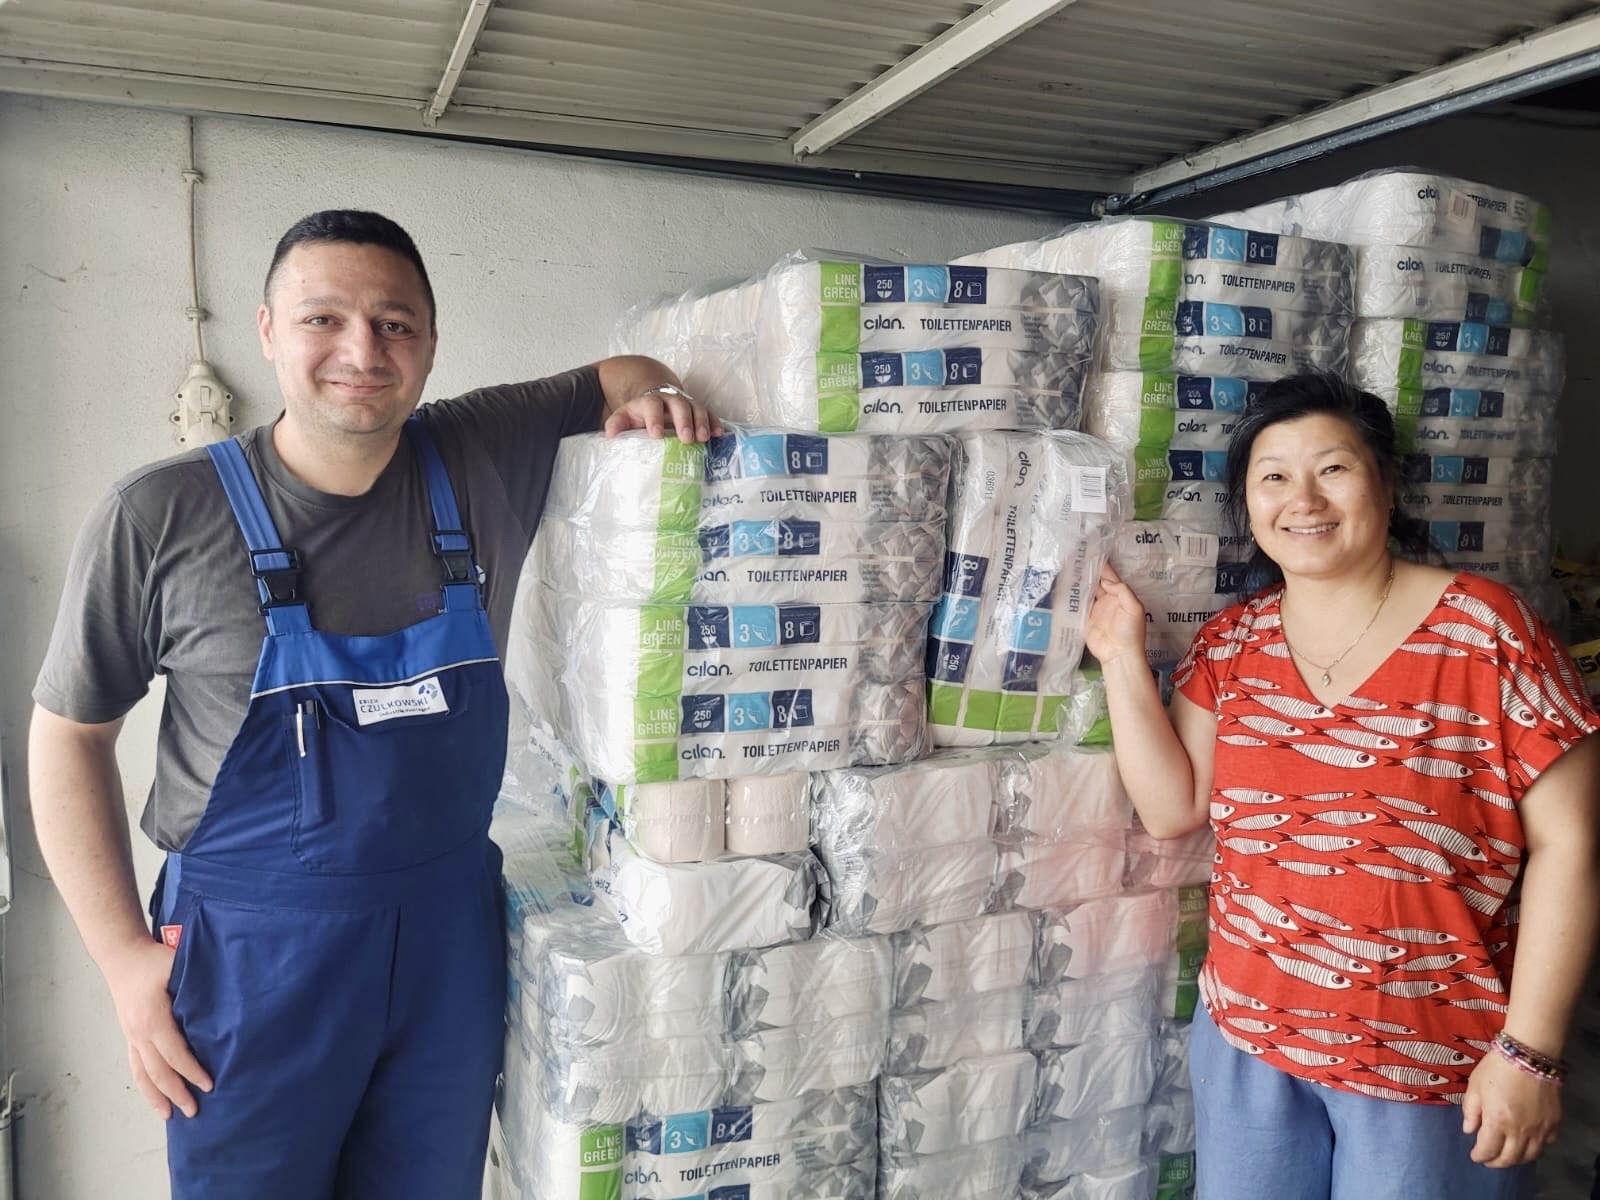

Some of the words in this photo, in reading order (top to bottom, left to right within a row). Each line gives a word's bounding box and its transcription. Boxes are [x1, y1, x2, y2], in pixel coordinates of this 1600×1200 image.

[1216, 239, 1225, 254] 3
[1250, 242, 1257, 258] 8
[835, 274, 857, 286] LINE
[1221, 274, 1295, 293] TOILETTENPAPIER
[824, 287, 858, 299] GREEN
[876, 279, 893, 289] 250
[914, 280, 923, 297] 3
[954, 281, 962, 298] 8
[920, 318, 1012, 332] TOILETTENPAPIER
[1211, 316, 1220, 331] 3
[1249, 318, 1256, 332] 8
[1465, 335, 1471, 348] 3
[1489, 336, 1496, 350] 8
[830, 363, 854, 375] LINE
[874, 364, 890, 375] 250
[911, 362, 921, 381] 3
[950, 362, 959, 380] 8
[820, 375, 857, 388] GREEN
[1154, 382, 1173, 392] LINE
[1218, 391, 1228, 406] 3
[918, 400, 1007, 413] TOILETTENPAPIER
[750, 452, 760, 471] 3
[792, 451, 801, 469] 8
[1146, 458, 1164, 467] LINE
[1138, 469, 1168, 480] GREEN
[1437, 464, 1444, 478] 3
[760, 490, 857, 503] TOILETTENPAPIER
[739, 532, 749, 552] 3
[784, 533, 793, 549] 8
[963, 560, 978, 571] 8
[748, 570, 847, 582] TOILETTENPAPIER
[1220, 573, 1227, 586] 8
[955, 606, 968, 615] 3
[656, 620, 681, 631] LINE
[1028, 616, 1042, 627] 3
[700, 625, 715, 635] 250
[739, 624, 748, 642] 3
[785, 621, 794, 638] 8
[644, 633, 681, 645] GREEN
[748, 658, 847, 672] TOILETTENPAPIER
[948, 655, 960, 671] 250
[360, 697, 428, 713] CZULKOWSKI
[650, 709, 675, 721] LINE
[694, 710, 711, 720] 250
[734, 708, 744, 725] 3
[777, 706, 786, 722] 8
[638, 722, 676, 735] GREEN
[743, 740, 840, 757] TOILETTENPAPIER
[597, 1134, 620, 1148] LINE
[671, 1130, 681, 1149] 3
[716, 1124, 725, 1138] 8
[680, 1153, 780, 1181] TOILETTENPAPIER
